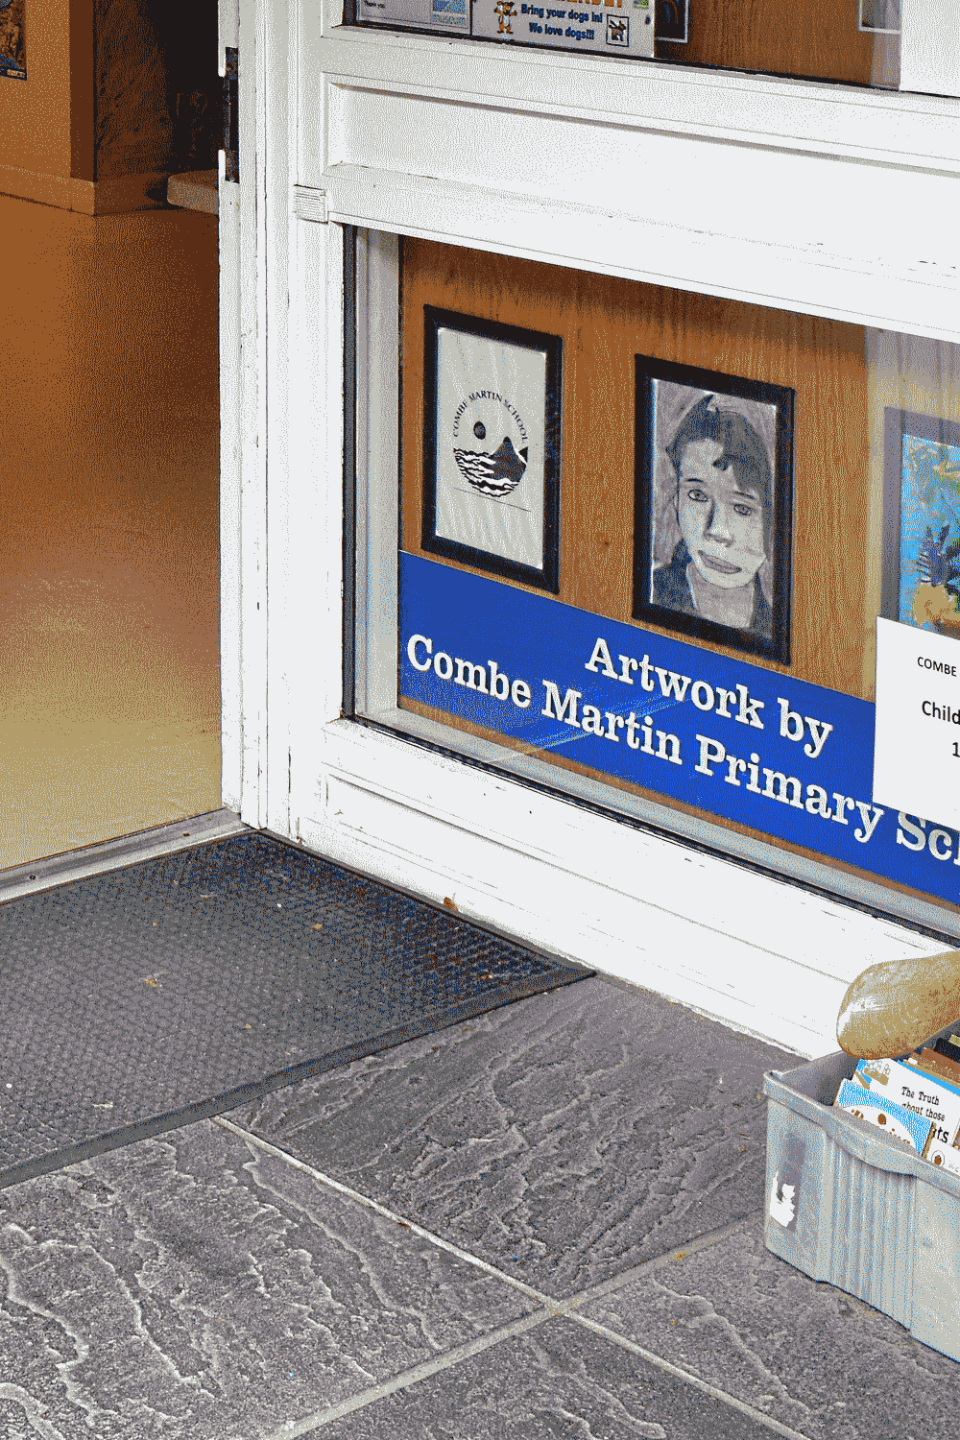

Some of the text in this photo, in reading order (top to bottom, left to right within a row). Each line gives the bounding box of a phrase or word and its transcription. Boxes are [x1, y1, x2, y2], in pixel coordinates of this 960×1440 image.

[521, 4, 544, 18] Bring
[547, 6, 566, 19] your
[568, 10, 589, 23] dogs
[529, 23, 594, 40] We love dogs!!!
[453, 391, 528, 443] COMBE MARTIN SCHOOL
[917, 656, 957, 677] COMBE
[584, 638, 832, 759] Artwork by
[406, 634, 960, 866] Combe Martin Primary Sc
[902, 1087, 939, 1105] The Truth
[926, 1109, 945, 1121] those
